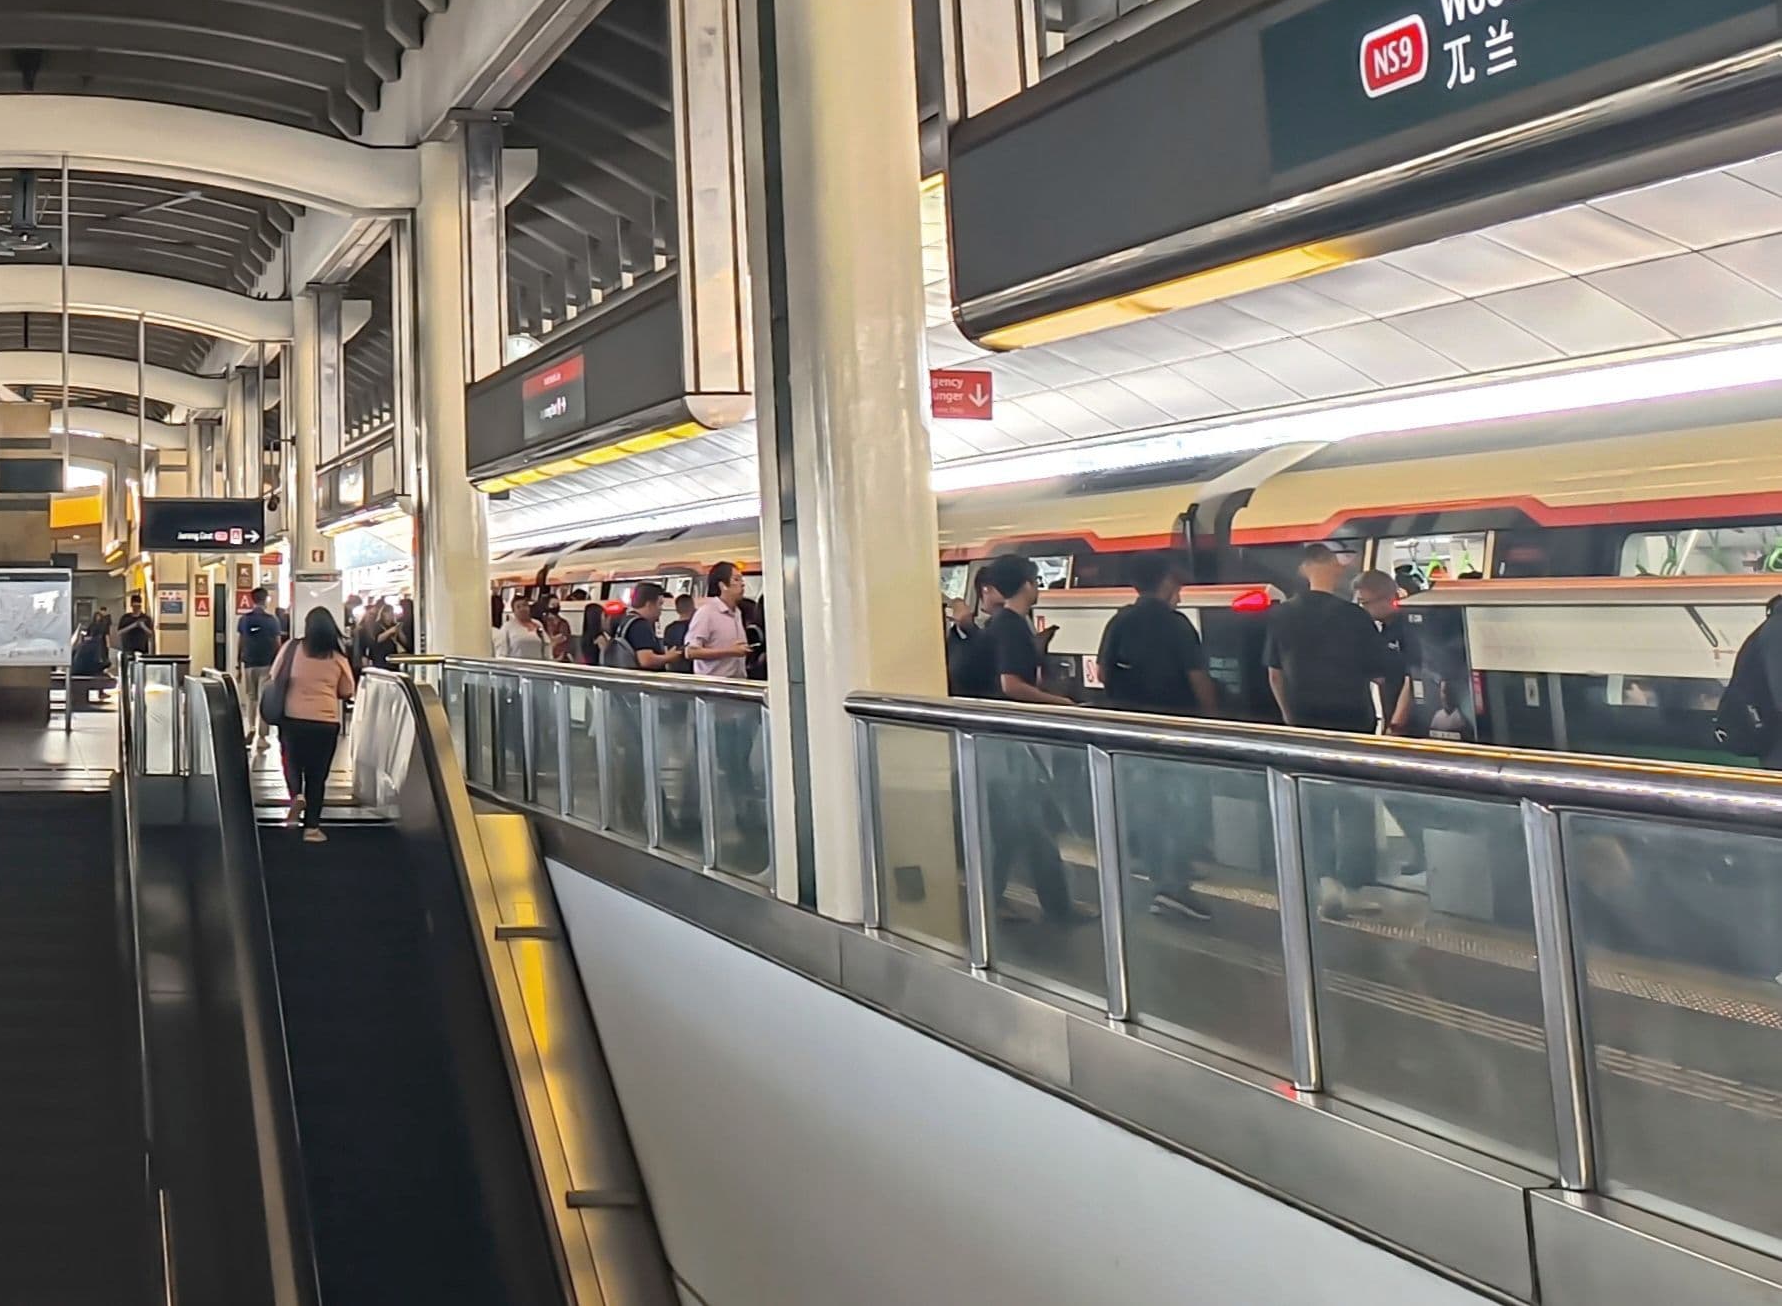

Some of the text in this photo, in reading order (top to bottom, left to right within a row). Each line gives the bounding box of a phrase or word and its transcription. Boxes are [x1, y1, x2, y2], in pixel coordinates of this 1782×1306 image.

[1372, 36, 1415, 80] NS9
[1443, 18, 1517, 90] 兀兰
[931, 378, 964, 389] gency
[932, 392, 964, 404] unger
[198, 599, 207, 611] A
[240, 594, 251, 608] A
